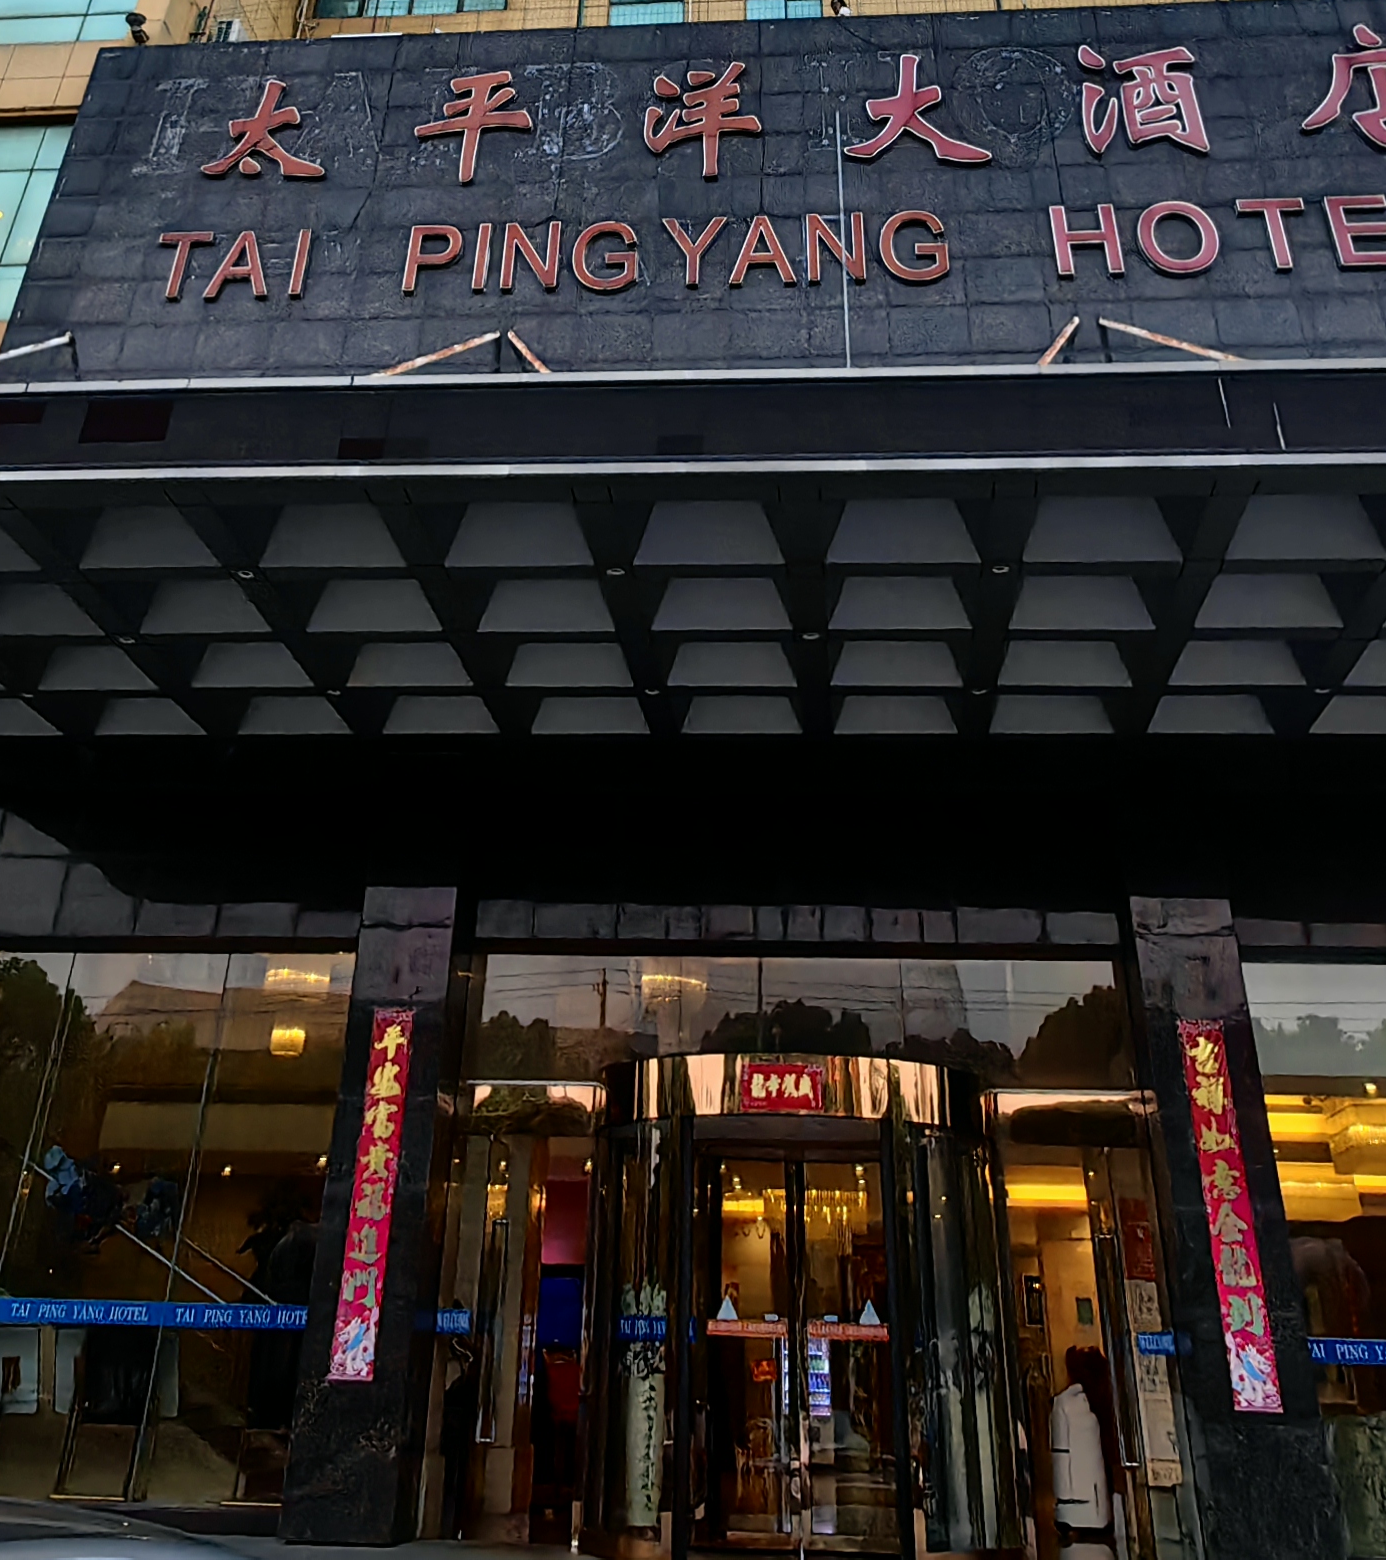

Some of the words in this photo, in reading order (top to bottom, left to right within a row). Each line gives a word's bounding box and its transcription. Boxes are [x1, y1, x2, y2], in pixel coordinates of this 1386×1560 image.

[159, 228, 311, 300] TAI
[11, 1303, 31, 1318] TAI
[38, 1304, 66, 1319] PING
[72, 1306, 104, 1321] YANG
[109, 1306, 149, 1322] HOTEL
[175, 1307, 195, 1323] TAI
[203, 1308, 232, 1324] PING
[239, 1309, 271, 1325] YANG
[1335, 1343, 1368, 1361] PING
